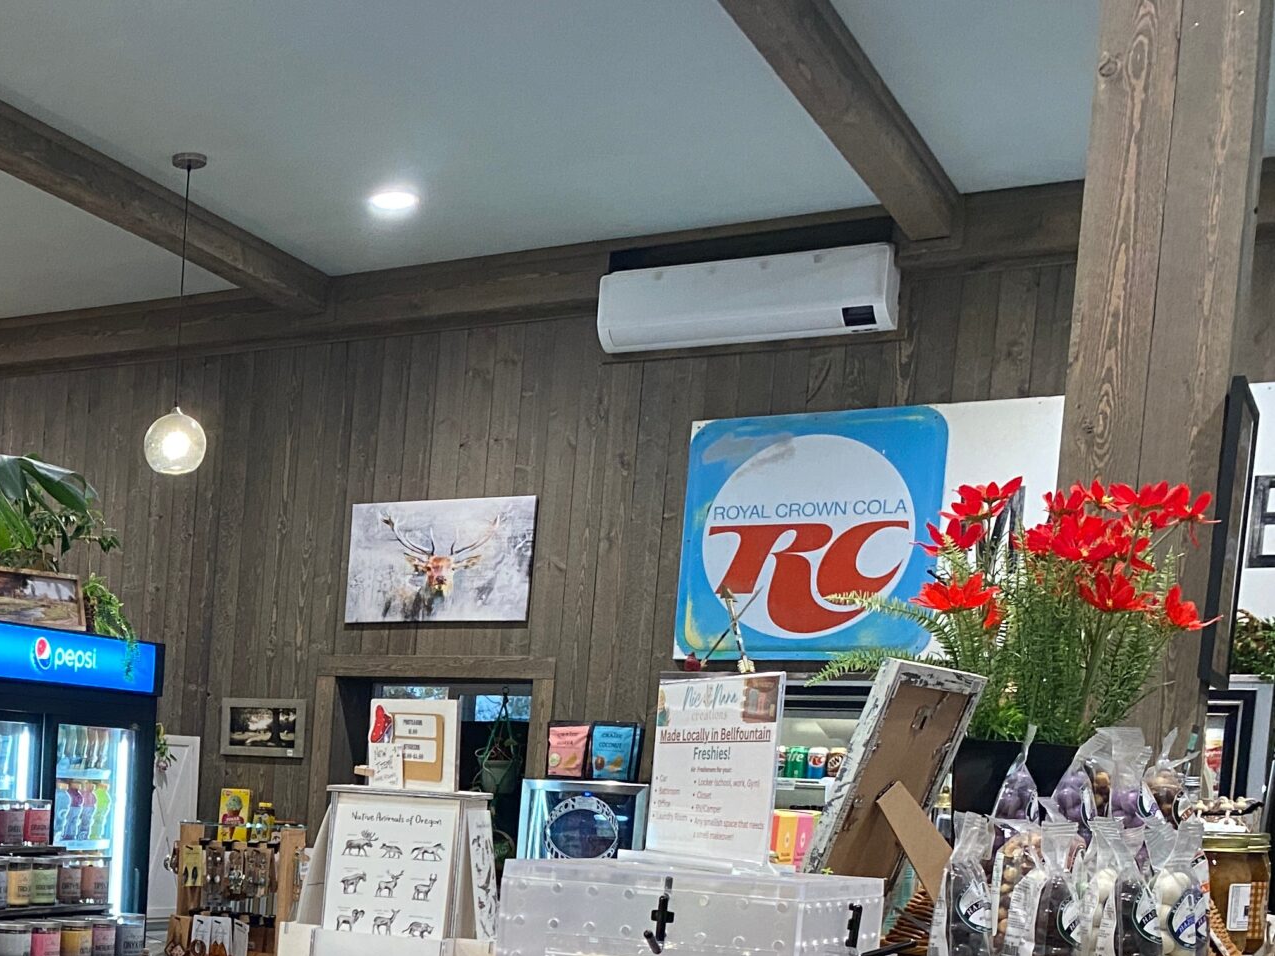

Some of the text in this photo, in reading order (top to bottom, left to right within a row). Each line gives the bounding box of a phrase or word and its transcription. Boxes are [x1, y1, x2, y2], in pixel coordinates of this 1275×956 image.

[713, 499, 907, 521] ROYAL CROWN COLA
[708, 520, 909, 634] RC
[54, 647, 97, 673] pepsi
[660, 726, 771, 744] Made Locally in Bellfountain
[693, 746, 731, 760] Freshies!
[746, 778, 760, 790] Gym)
[351, 811, 442, 827] Native Animals of Oregon
[655, 812, 673, 821] Laundry
[694, 817, 703, 827] Any
[723, 820, 737, 829] space
[738, 820, 748, 829] that
